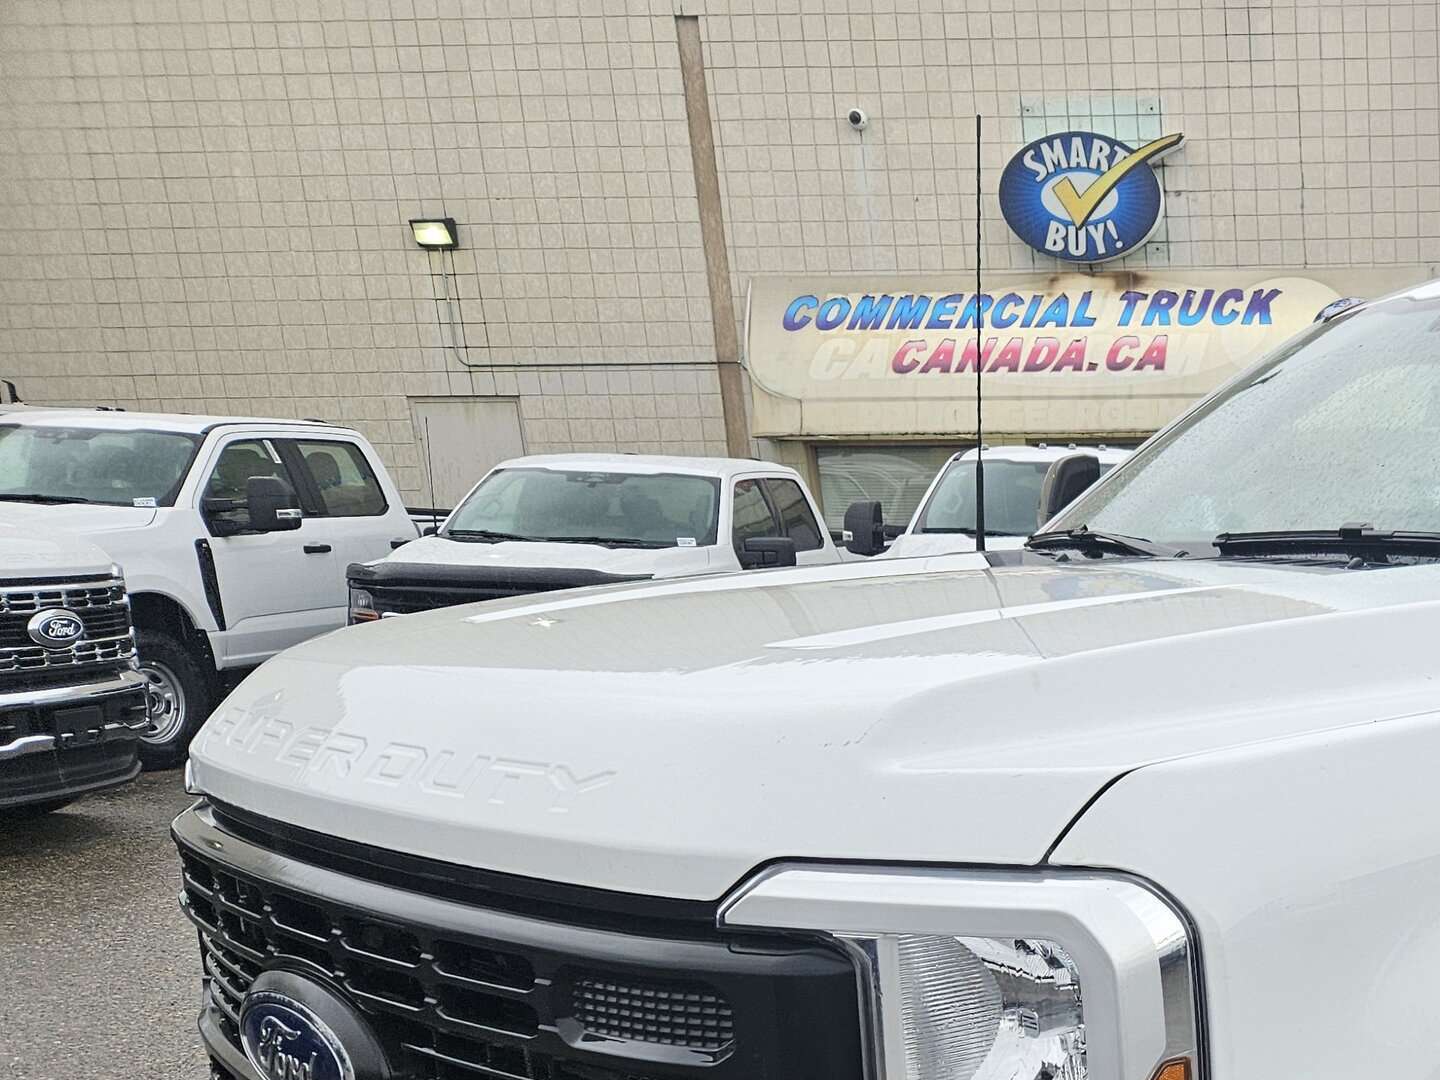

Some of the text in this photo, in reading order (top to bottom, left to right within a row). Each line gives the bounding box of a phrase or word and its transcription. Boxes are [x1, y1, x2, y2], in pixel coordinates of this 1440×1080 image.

[1022, 136, 1132, 183] SMART
[1044, 219, 1124, 257] BUY!
[782, 287, 1283, 332] COMMERCIAL TRUCK
[891, 334, 1169, 374] CANADA.CA
[48, 620, 76, 637] Ford
[202, 706, 617, 813] SUPER DUTY
